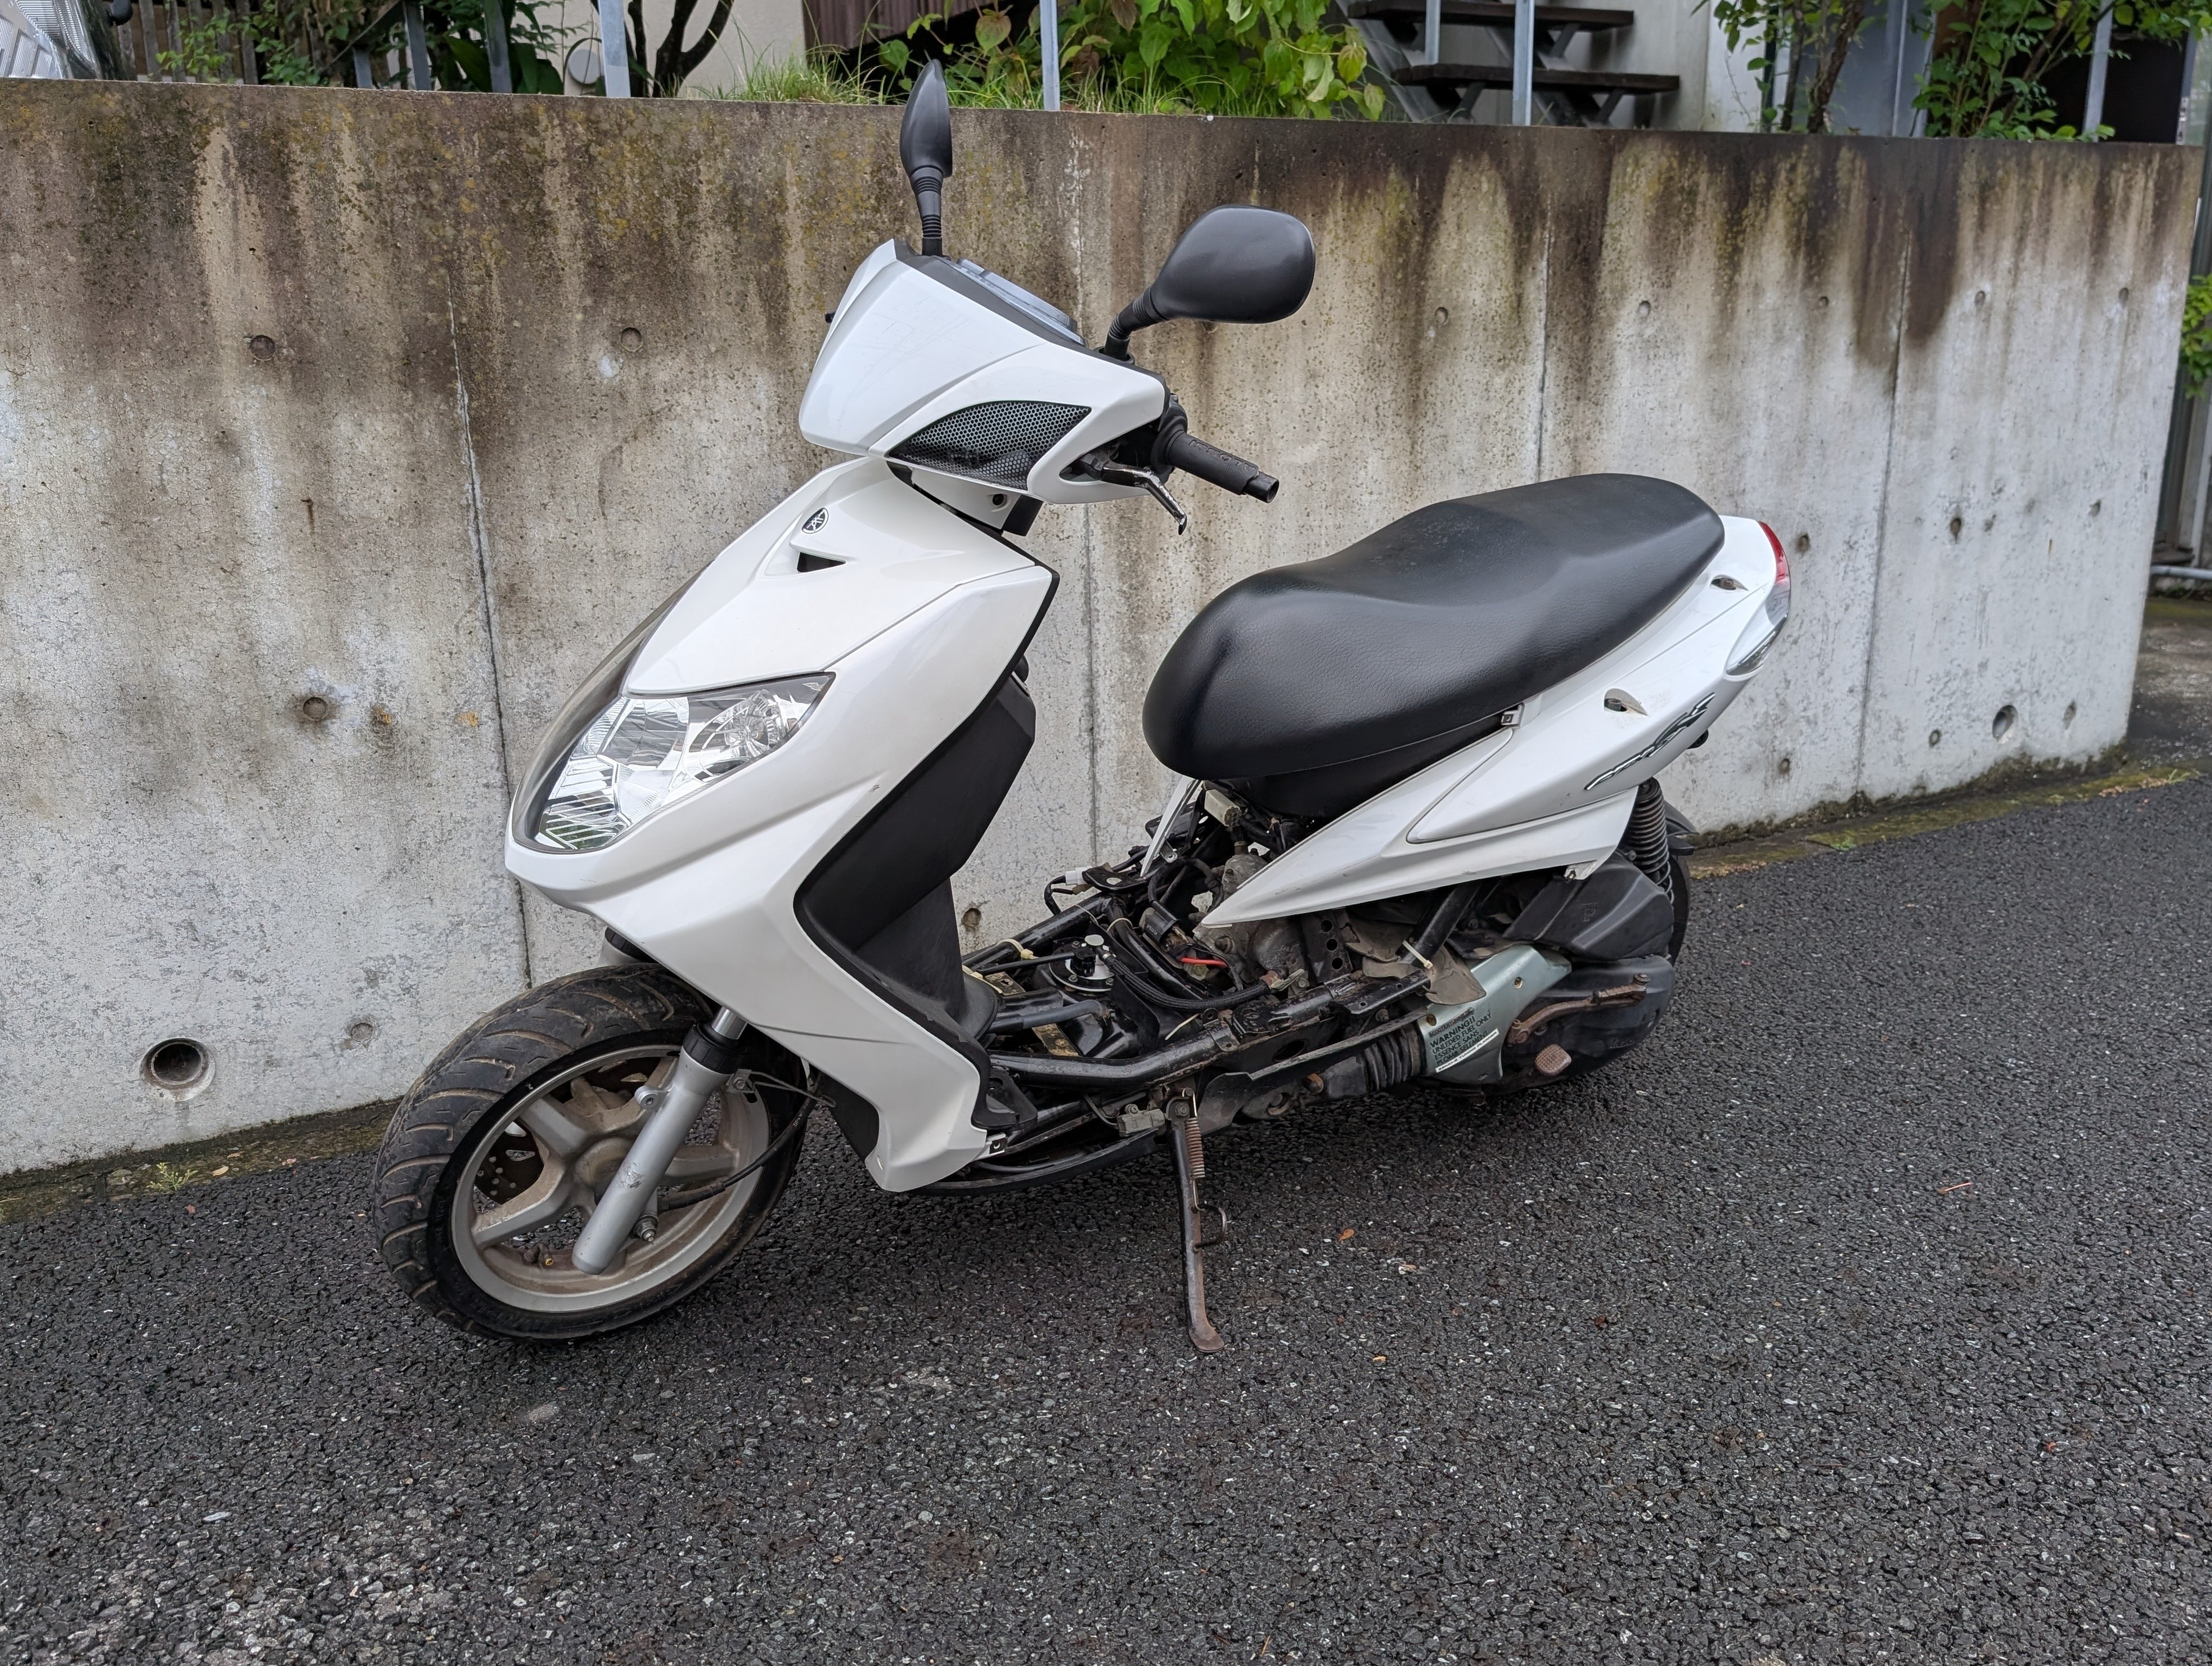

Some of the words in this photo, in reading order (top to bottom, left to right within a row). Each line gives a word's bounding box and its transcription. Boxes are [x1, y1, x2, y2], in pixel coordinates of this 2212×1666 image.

[1430, 1016, 1475, 1047] WARNING!!
[1462, 1026, 1475, 1037] FUEL
[1476, 1012, 1491, 1027] ONLY
[1435, 1041, 1461, 1060] ESSENCE
[1463, 1030, 1479, 1044] SANS
